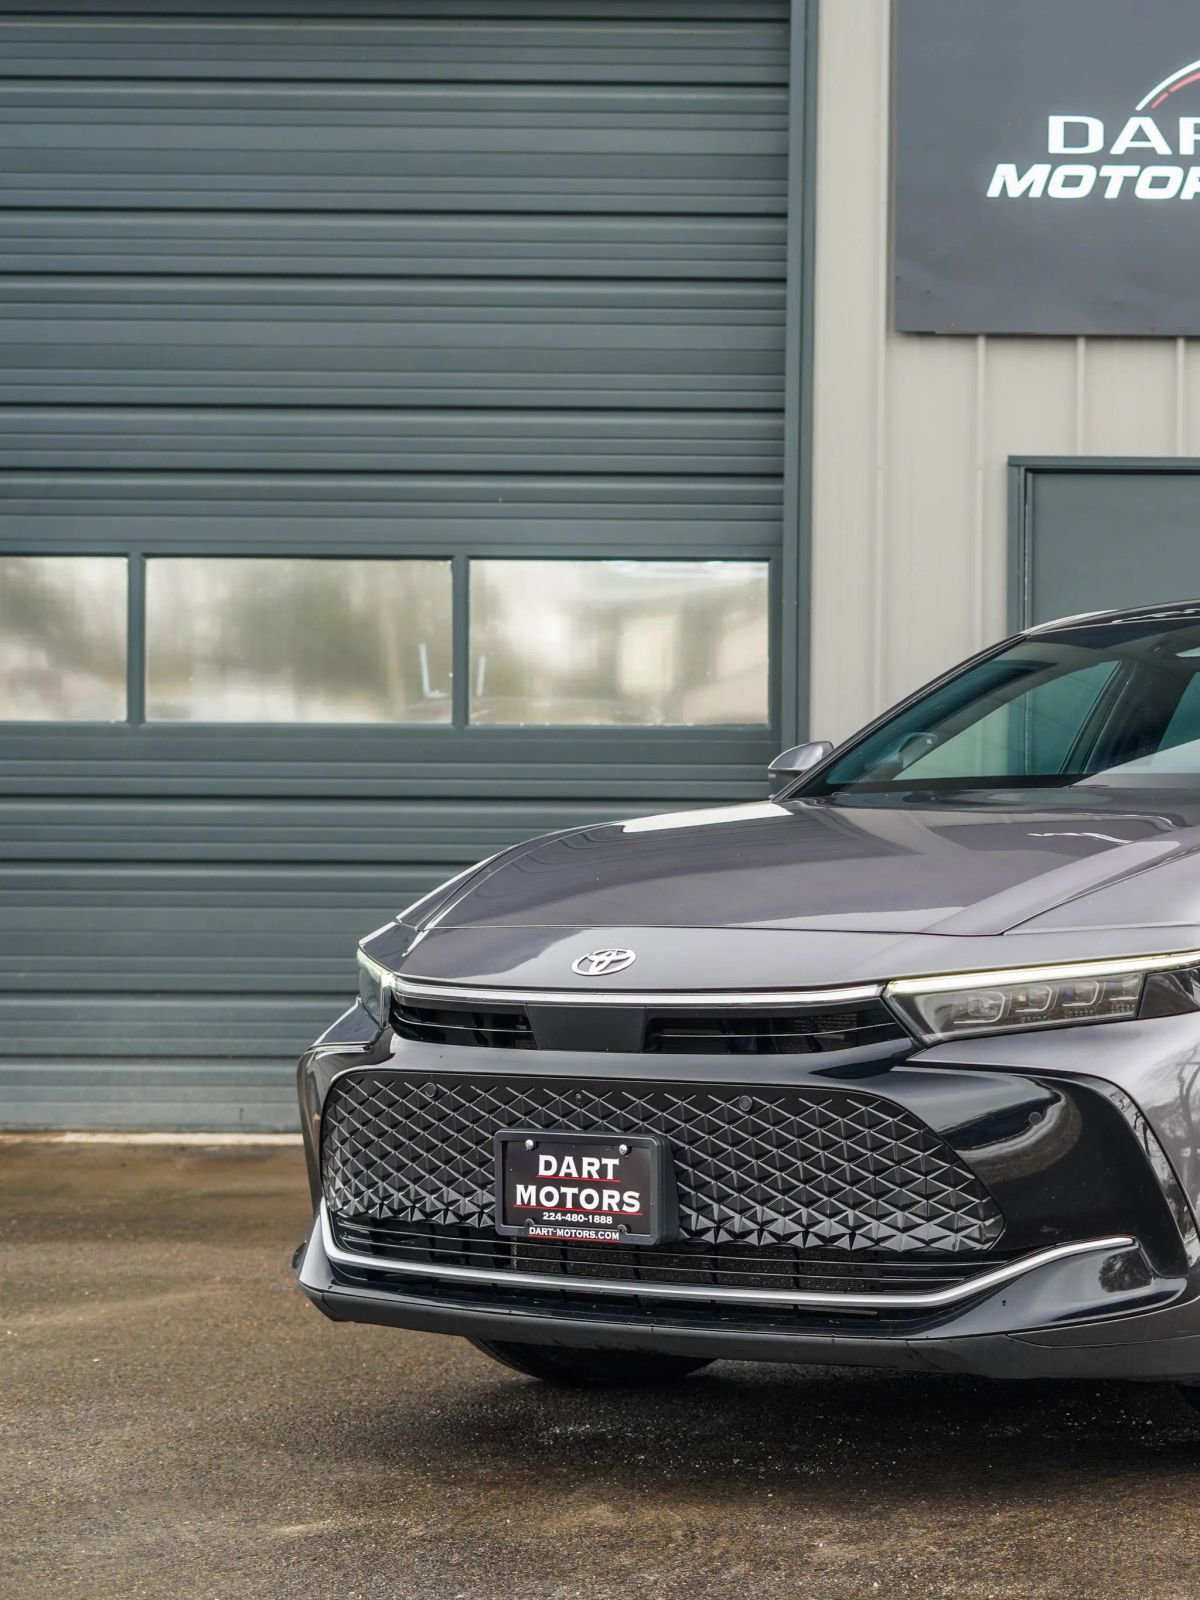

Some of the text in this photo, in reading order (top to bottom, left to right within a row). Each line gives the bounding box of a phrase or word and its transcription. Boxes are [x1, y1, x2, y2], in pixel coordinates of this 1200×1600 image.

[538, 1154, 620, 1180] DART
[516, 1184, 641, 1212] MOTORS
[542, 1212, 613, 1224] 224-480-1888
[529, 1226, 620, 1241] DART-MOTORS.COM
